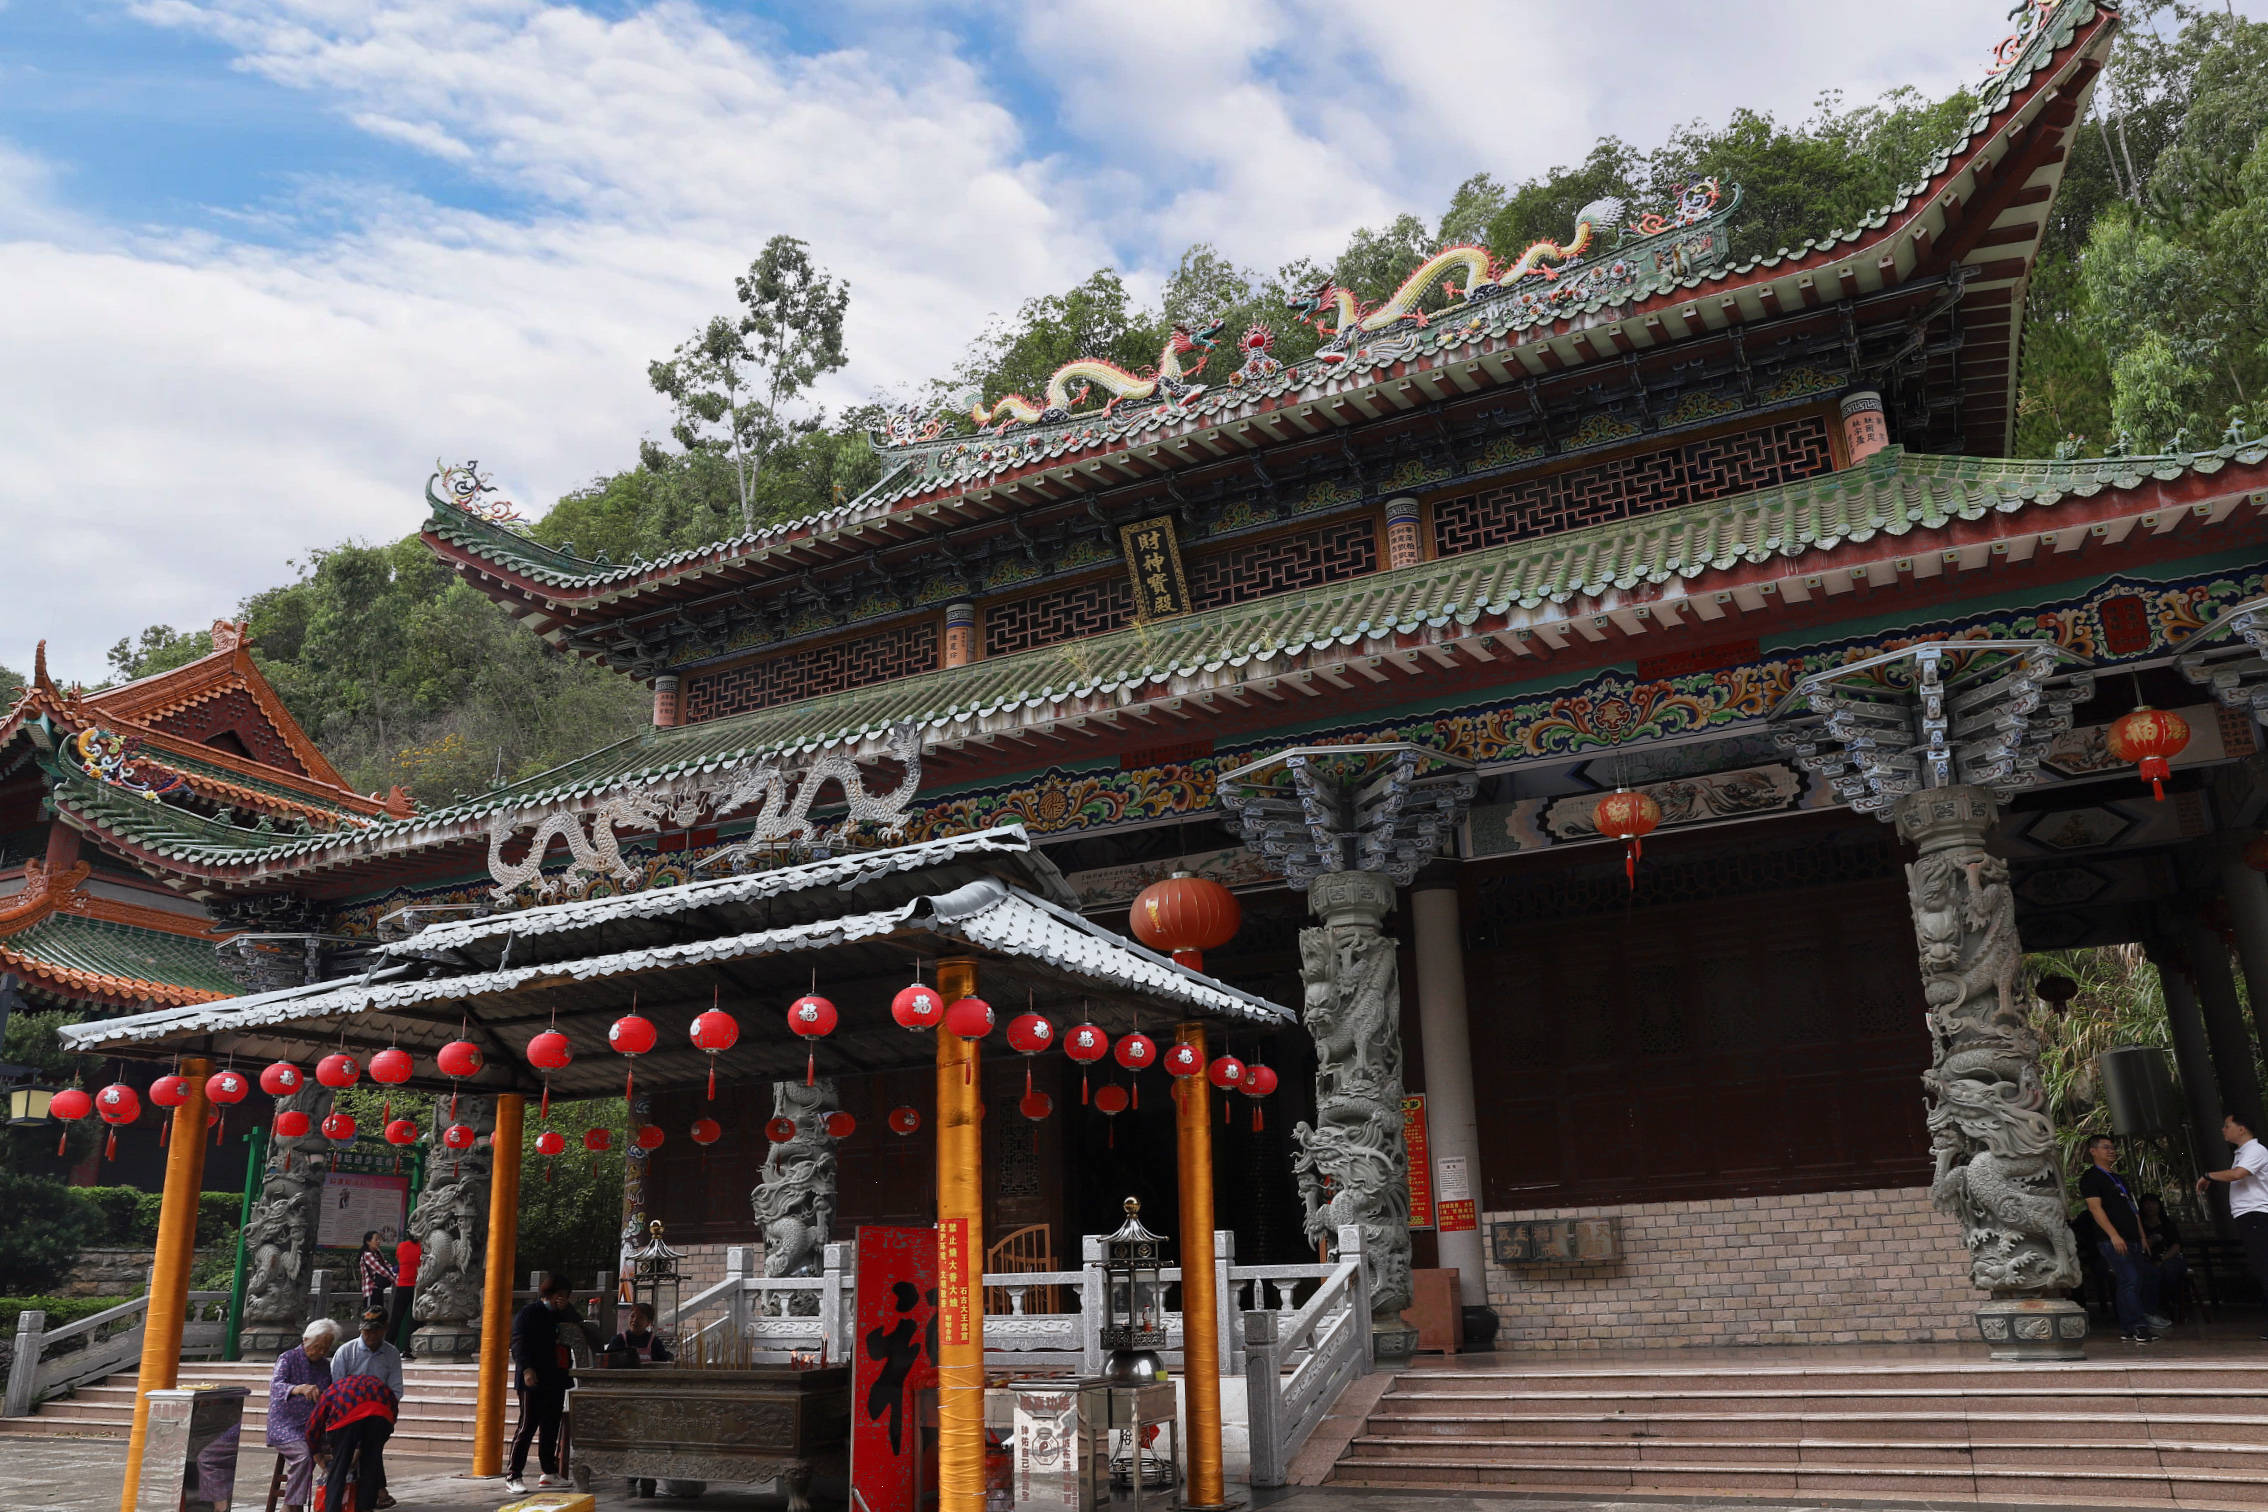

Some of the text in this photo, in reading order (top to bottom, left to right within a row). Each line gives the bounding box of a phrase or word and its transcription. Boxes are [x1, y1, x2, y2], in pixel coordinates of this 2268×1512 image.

[1137, 530, 1178, 614] 財神寶殿
[2125, 713, 2158, 742] 福
[799, 1003, 818, 1022] 福
[912, 994, 931, 1014] 福
[1033, 1020, 1049, 1039] 福
[1077, 1030, 1094, 1047] 福
[1129, 1041, 1144, 1057] 福
[1177, 1049, 1193, 1064] 福
[1224, 1063, 1239, 1079] 福
